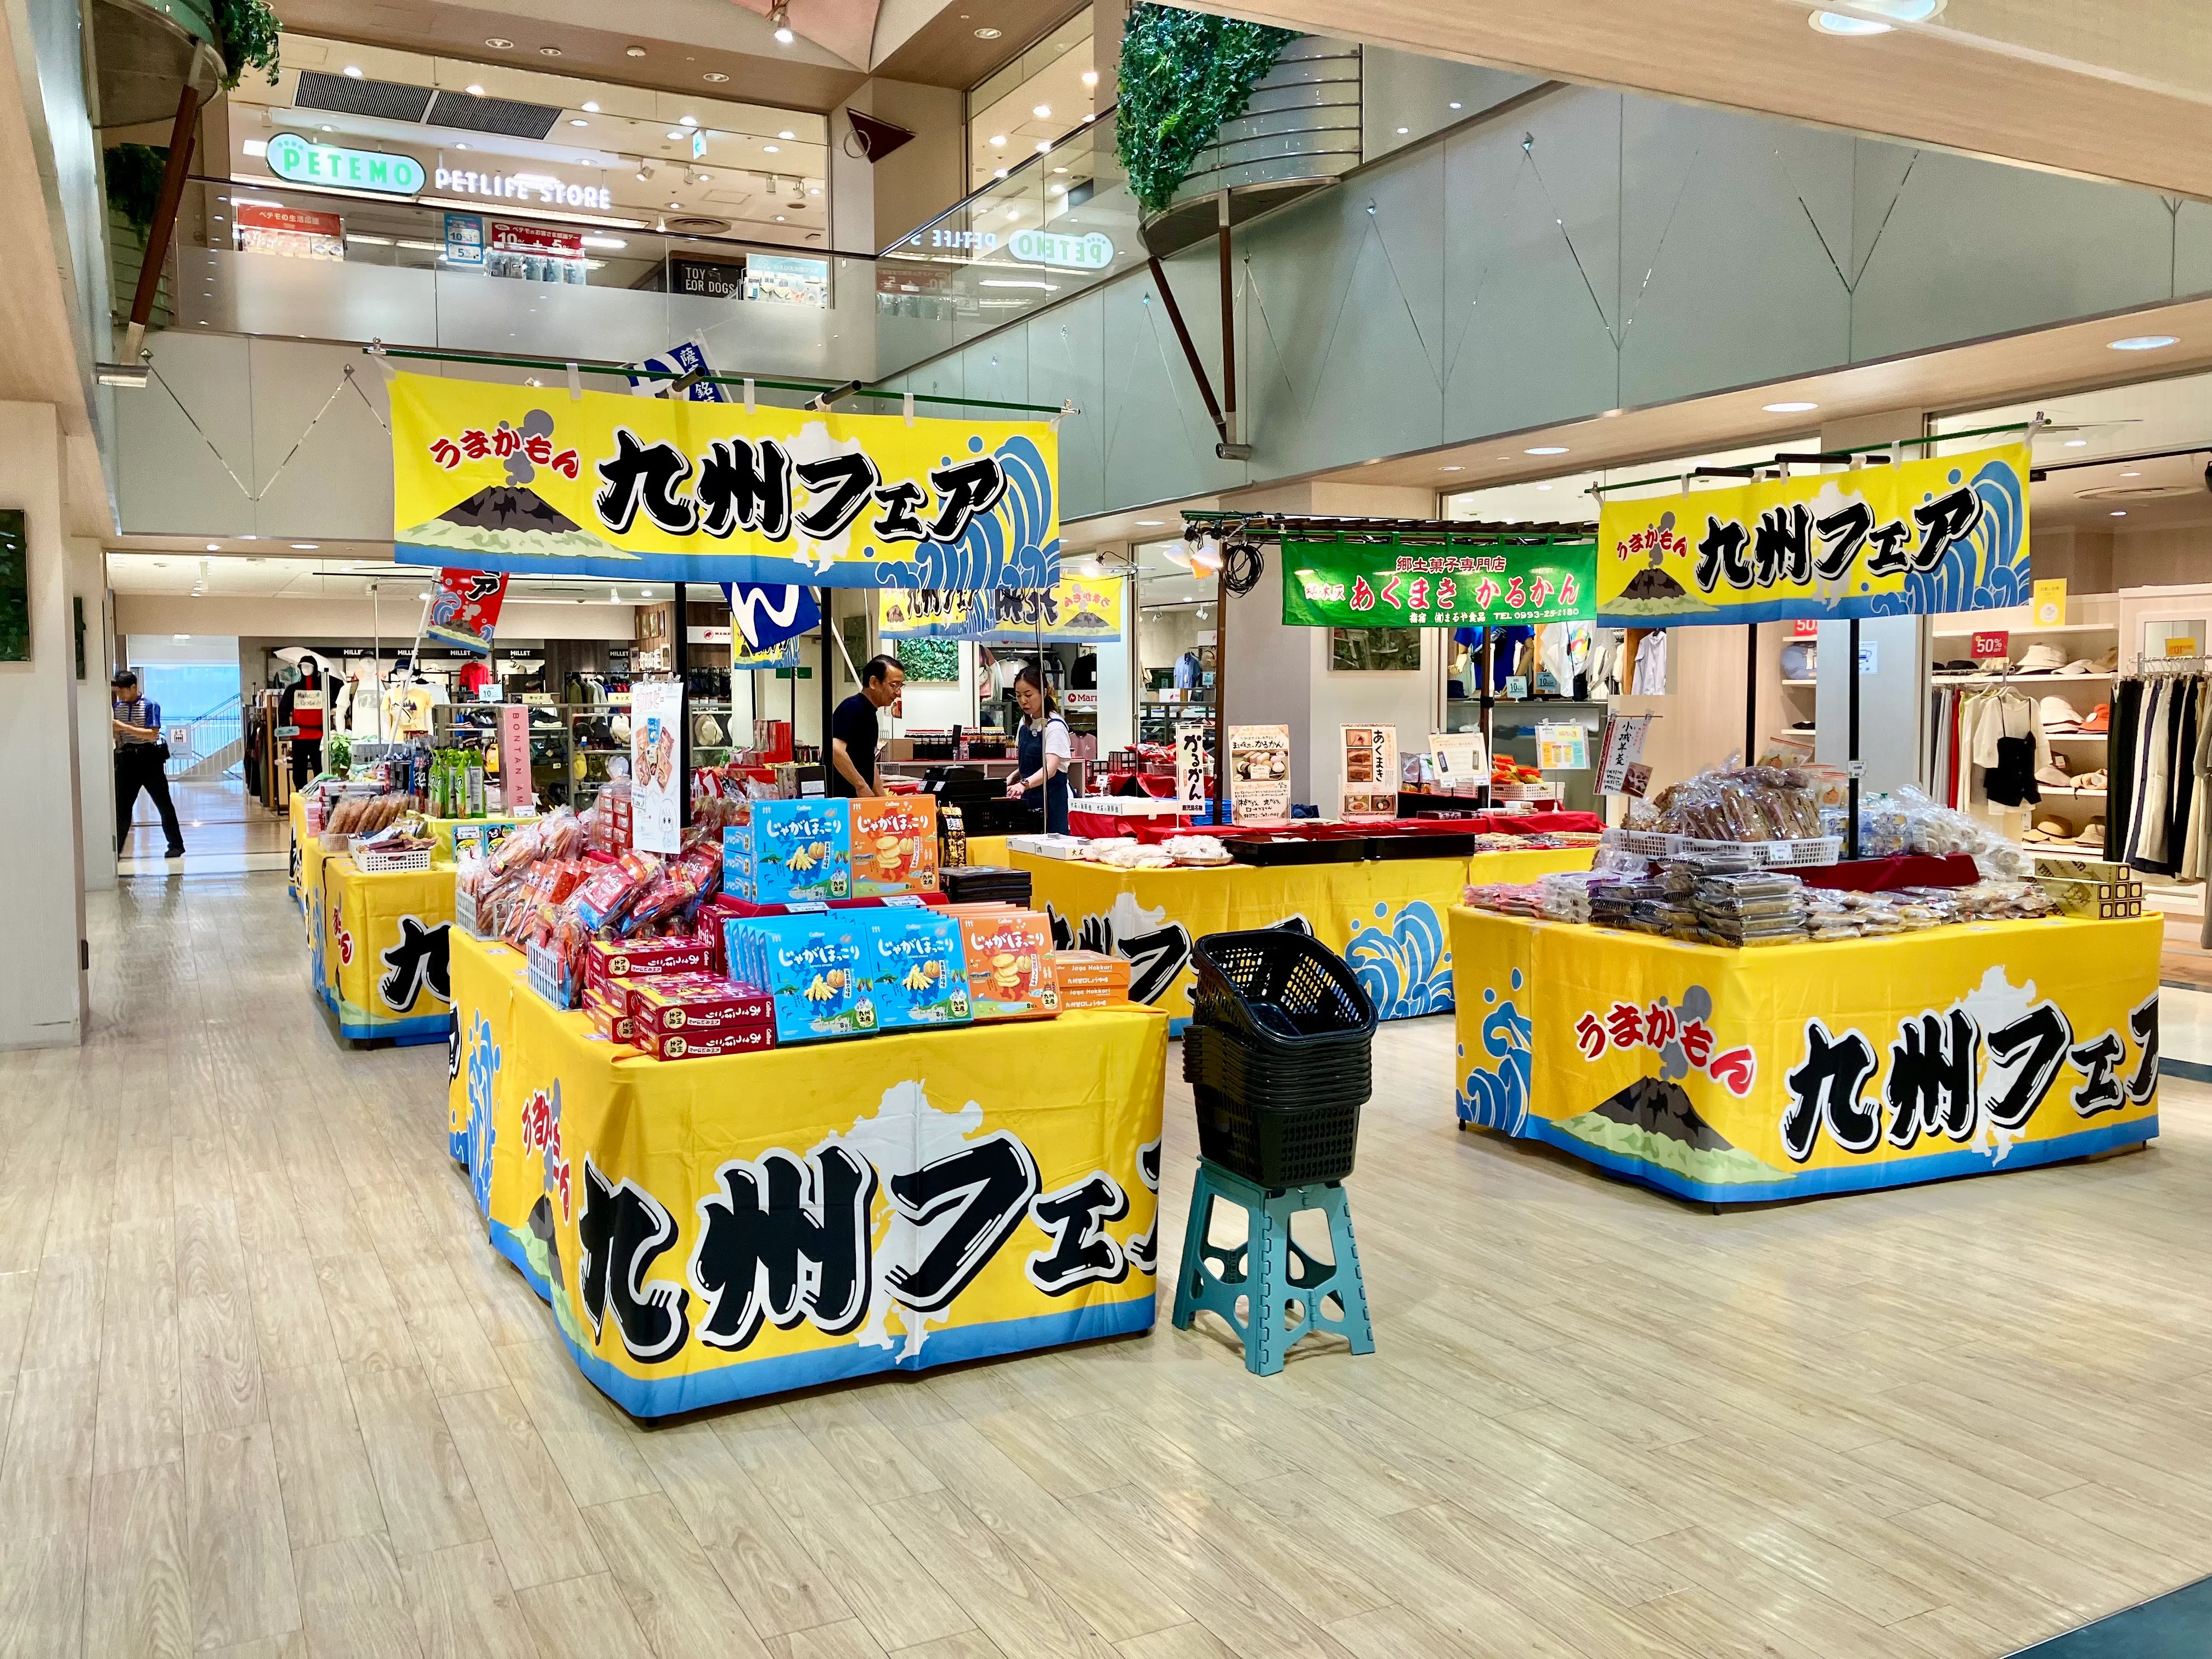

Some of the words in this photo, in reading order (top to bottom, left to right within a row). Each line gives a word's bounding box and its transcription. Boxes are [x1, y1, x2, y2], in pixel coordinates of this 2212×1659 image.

[283, 148, 413, 187] PETEMO
[435, 167, 528, 201] PETLIFE
[539, 182, 611, 210] STORE
[685, 267, 706, 279] TOY
[708, 281, 735, 294] DOGS
[431, 427, 581, 481] うまかもん
[595, 429, 1011, 543] 九州フェア
[1615, 524, 1689, 561] うまかもん
[1694, 485, 1983, 592] 九州フェア
[1396, 555, 1507, 573] 郷土菓子専門店
[1350, 574, 1458, 611] あくまき
[1476, 573, 1581, 607] かるかん
[1409, 611, 1427, 624] 指宿
[1493, 611, 1513, 620] TEL
[1514, 607, 1579, 620] 0993-25-2180
[1977, 638, 2002, 653] 50%
[512, 712, 522, 775] BONTAN
[1373, 729, 1385, 782] あくまき
[1183, 734, 1203, 801] かるかん
[766, 818, 842, 838] じゃがほっこり
[857, 815, 928, 833] じゃがほっこり
[878, 936, 953, 957] じゃがほっこり
[970, 932, 1045, 951] じゃがほっこり
[614, 960, 620, 970] 土産
[620, 959, 627, 971] 九州
[647, 955, 699, 967] おさつほっこり
[778, 945, 860, 967] じゃがほっこり
[669, 1012, 675, 1024] 土産
[675, 1011, 682, 1024] 九州
[706, 1005, 761, 1019] おさつほっこり
[670, 1040, 676, 1053] 土産
[676, 1039, 683, 1053] 九州
[706, 1033, 761, 1047] おさつほっこり
[1575, 998, 1755, 1099] うまかもん
